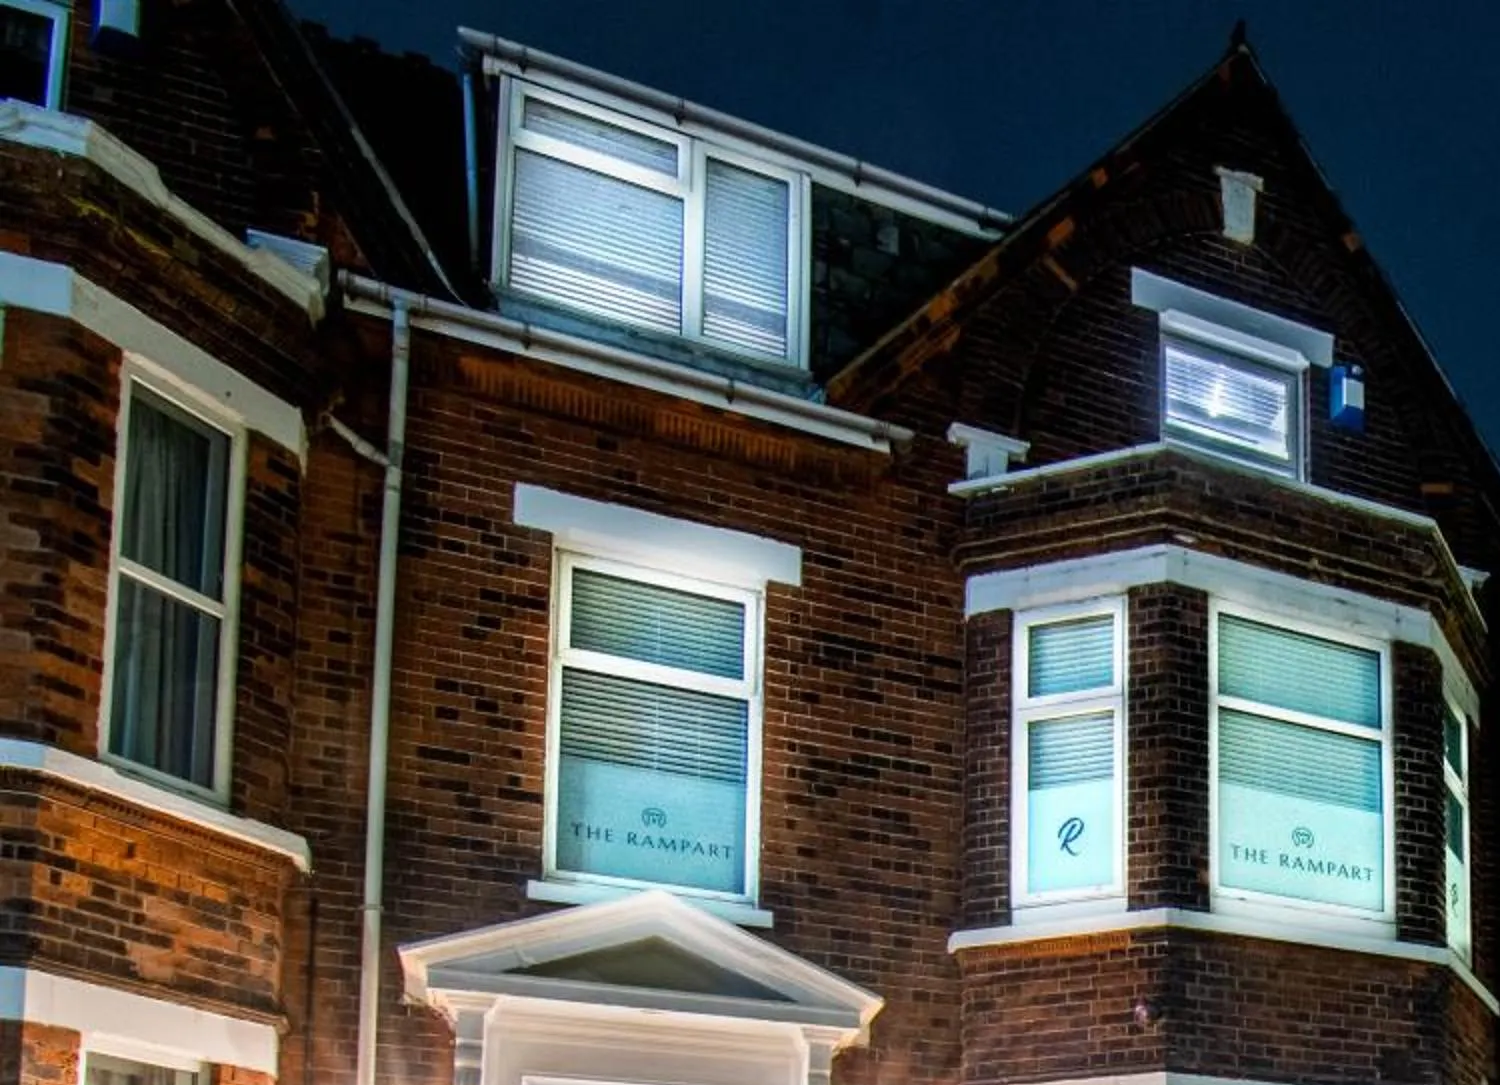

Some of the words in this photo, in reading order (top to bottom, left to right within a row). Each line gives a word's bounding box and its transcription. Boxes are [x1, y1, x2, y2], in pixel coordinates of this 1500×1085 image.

[571, 821, 614, 843] THE
[627, 831, 734, 860] RAMPART
[1057, 817, 1084, 857] R
[1230, 843, 1269, 864] THE
[1279, 853, 1374, 881] RAMPART
